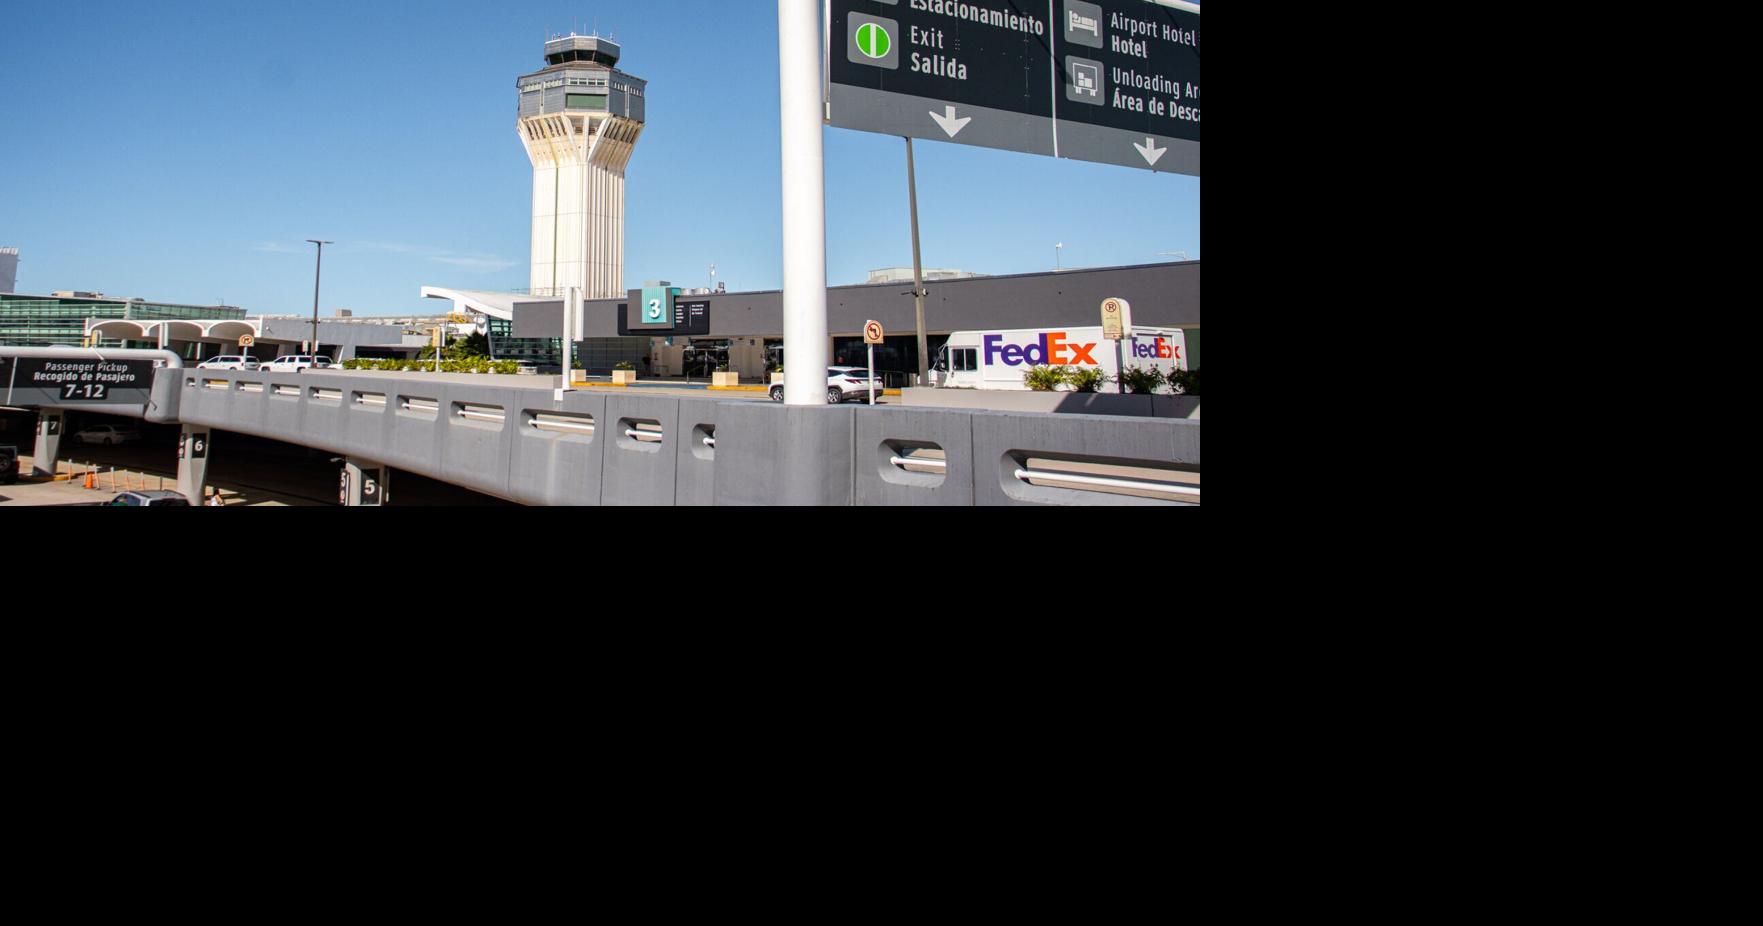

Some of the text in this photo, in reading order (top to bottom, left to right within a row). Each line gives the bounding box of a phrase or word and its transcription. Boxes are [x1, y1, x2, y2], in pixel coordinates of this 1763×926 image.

[911, 25, 944, 49] Exit
[1111, 12, 1196, 47] Airport Hotel
[1112, 35, 1147, 58] Hotel
[911, 52, 967, 80] Salida
[1113, 67, 1200, 100] Unloading Ar
[1113, 87, 1200, 122] Área de Desc
[648, 299, 661, 318] 3
[983, 331, 1098, 366] FedEx
[1131, 336, 1181, 360] FedEx
[34, 372, 135, 383] Recogido de Pasajero
[45, 361, 128, 373] Passenger Pickup
[65, 384, 104, 398] 7-12
[50, 421, 57, 430] 7
[194, 440, 203, 452] 6
[364, 479, 376, 495] 5
